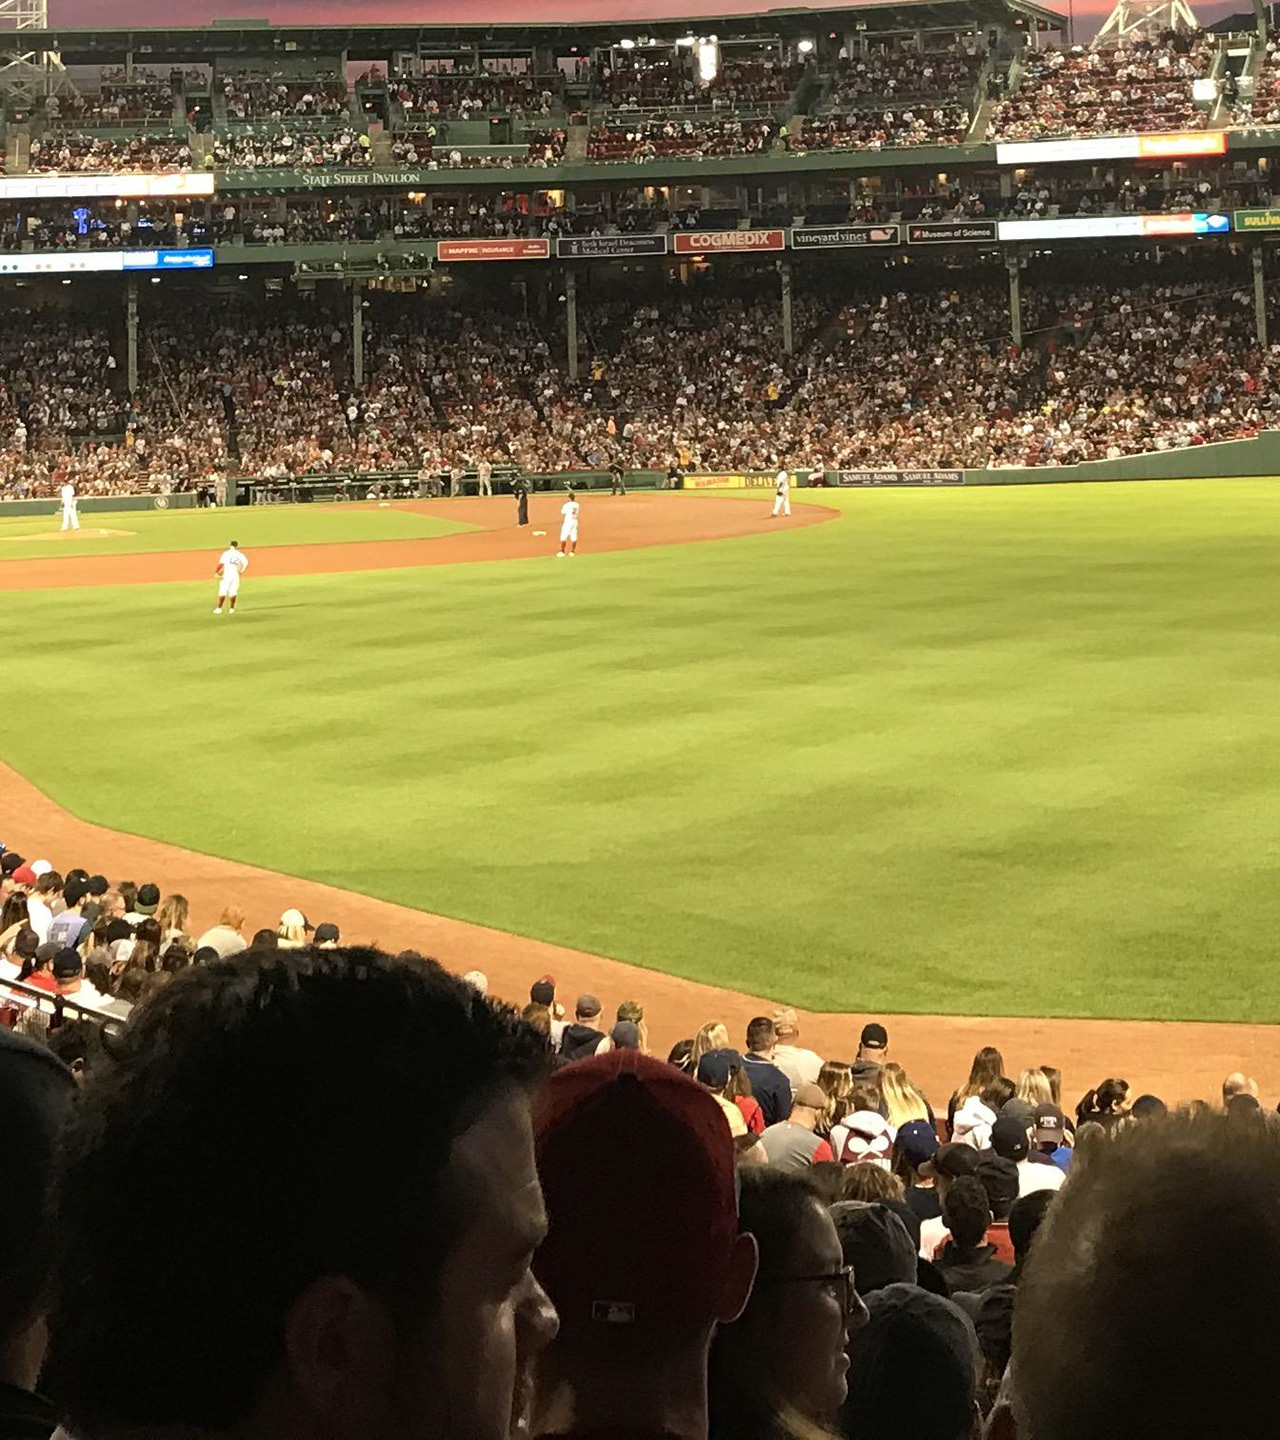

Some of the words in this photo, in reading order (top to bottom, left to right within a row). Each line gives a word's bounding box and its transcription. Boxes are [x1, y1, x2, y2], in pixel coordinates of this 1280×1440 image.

[302, 174, 332, 186] STATE
[334, 173, 369, 184] STREET
[372, 173, 420, 184] PAVILION
[795, 232, 839, 245] vineyard
[840, 231, 867, 242] vines
[922, 230, 952, 238] Museum
[954, 229, 961, 237] of
[963, 228, 991, 237] Science
[690, 233, 769, 247] COGMEDIX
[873, 472, 898, 482] ADAMS
[933, 472, 959, 482] ADAMS
